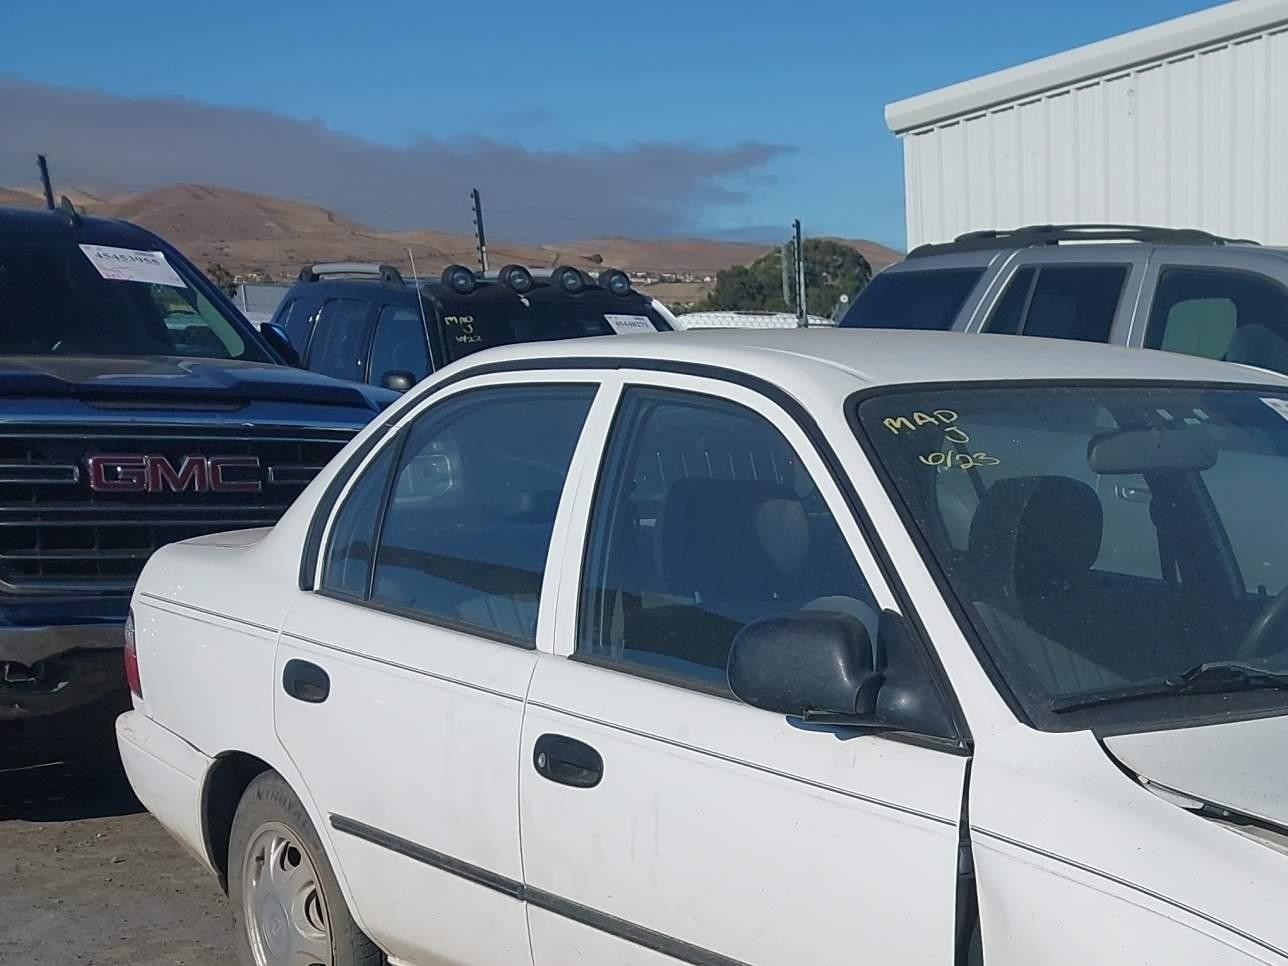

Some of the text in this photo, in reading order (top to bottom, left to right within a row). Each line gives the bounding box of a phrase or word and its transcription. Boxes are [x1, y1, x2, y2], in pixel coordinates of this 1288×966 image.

[883, 409, 958, 434] MAD
[944, 426, 969, 444] J
[919, 450, 1000, 471] 6/23
[89, 456, 262, 492] GMC
